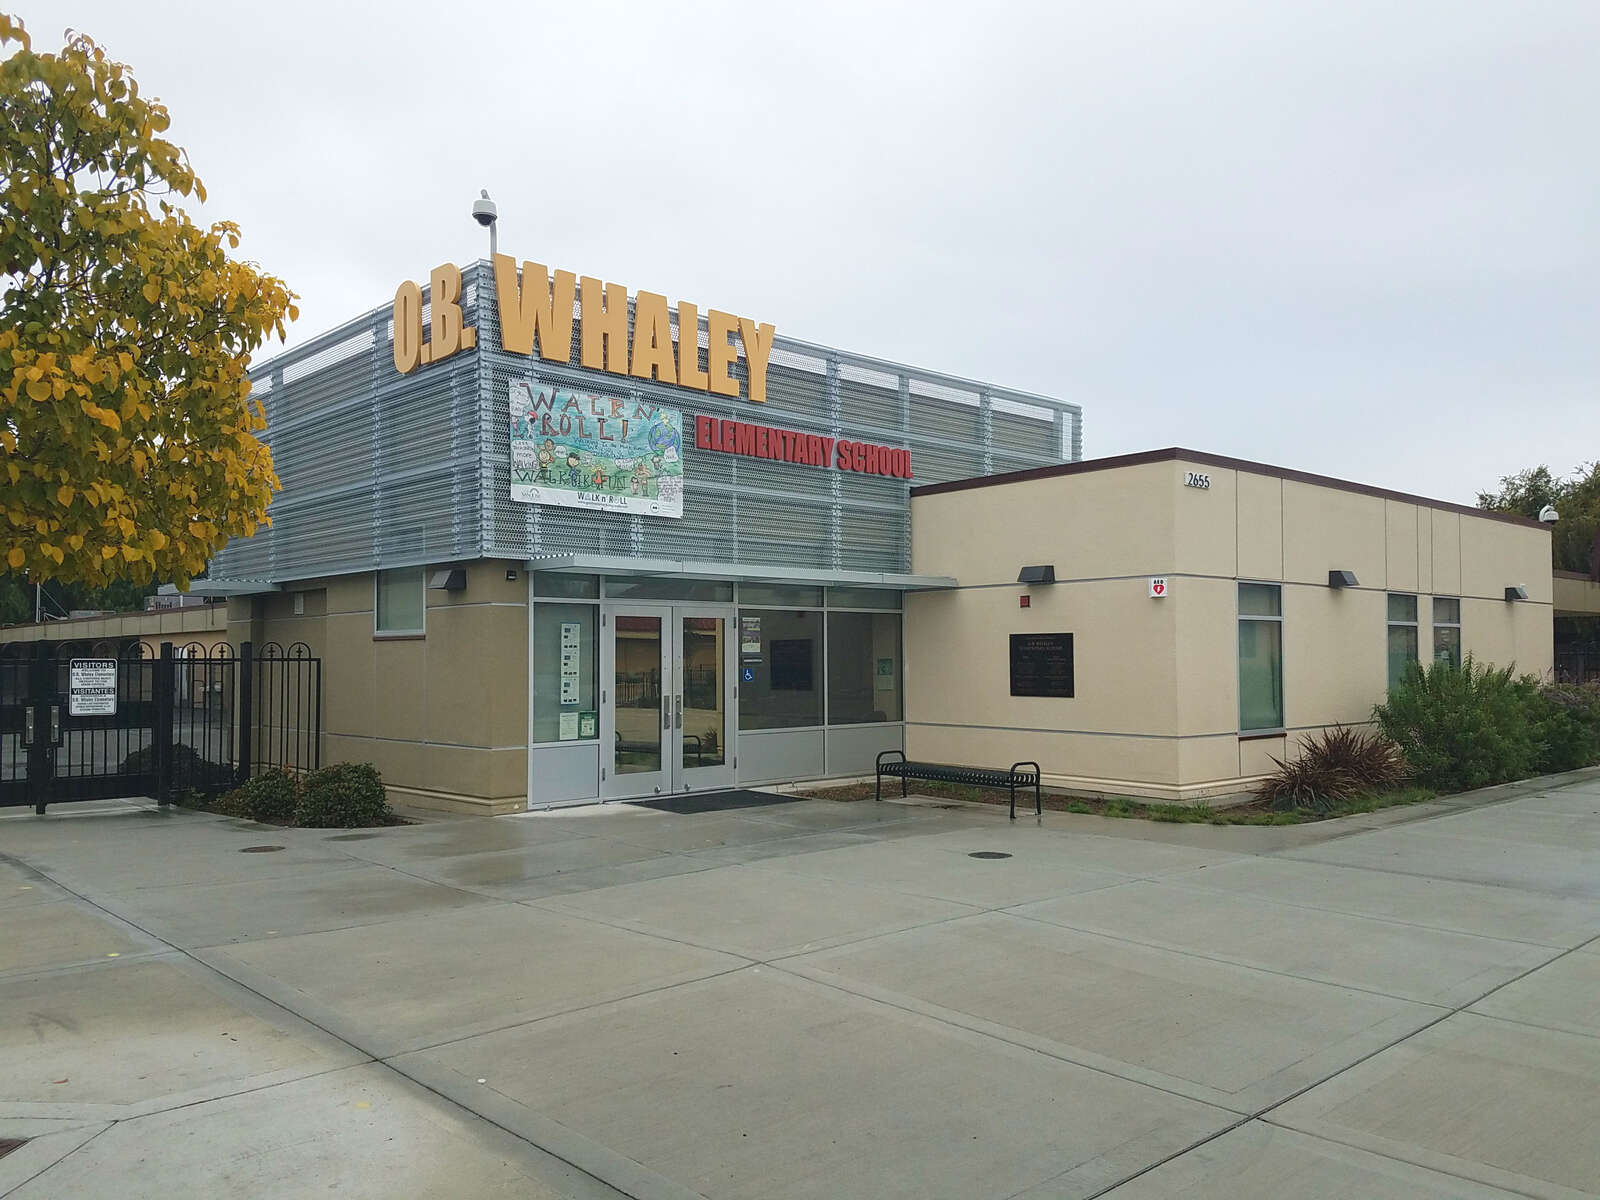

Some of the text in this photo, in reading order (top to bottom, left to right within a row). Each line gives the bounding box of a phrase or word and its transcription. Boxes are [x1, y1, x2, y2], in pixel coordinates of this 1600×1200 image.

[393, 253, 776, 403] O.B. WHALEY
[519, 383, 625, 418] WALK
[539, 412, 629, 443] ROLL!
[695, 415, 914, 479] ELEMENTARY SCHOOL
[512, 468, 569, 485] WALK
[1187, 472, 1210, 488] 2655
